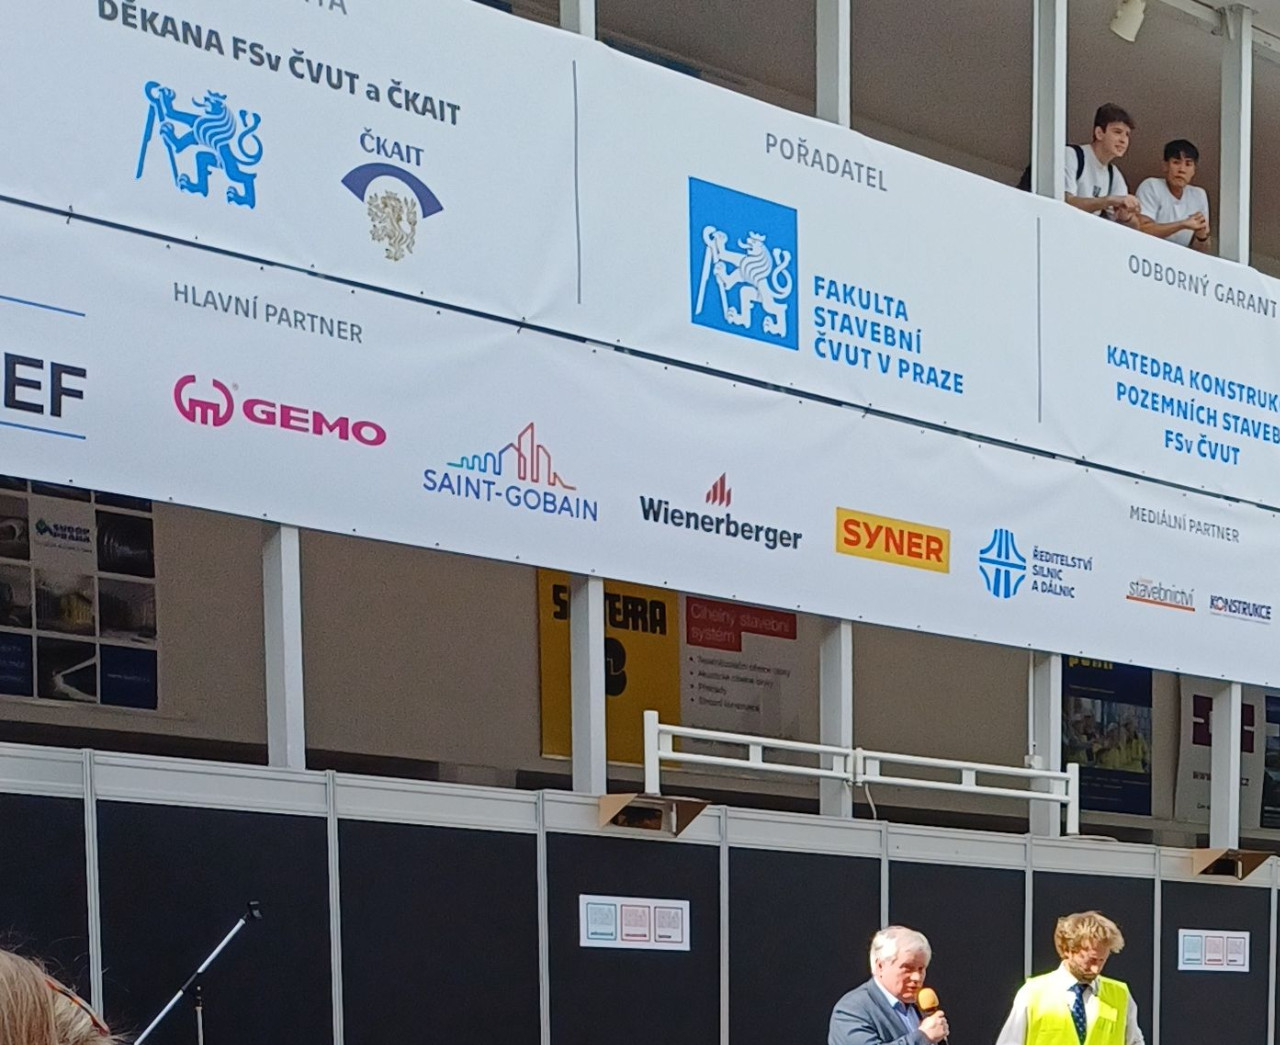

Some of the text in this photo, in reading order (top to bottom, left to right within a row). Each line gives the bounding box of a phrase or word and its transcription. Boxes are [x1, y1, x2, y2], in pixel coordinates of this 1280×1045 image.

[98, 0, 461, 125] DĚKANA FSv ČVUT a ČKAIT
[359, 127, 424, 166] ČKAIT
[766, 133, 887, 192] POŘADATEL
[813, 276, 908, 321] FAKULTA
[1128, 254, 1277, 318] ODBORNÝ GARANT
[173, 281, 363, 344] HLAVNÍ PARTNER
[813, 306, 922, 354] STAVEBNÍ
[813, 331, 964, 394] ČVUT V PRAZE
[1107, 345, 1184, 386] KATEDRA
[242, 398, 387, 447] GEMO
[1116, 381, 1217, 429] POZEMNÍCH
[1164, 429, 1240, 466] FSv ČVUT
[423, 468, 598, 522] SAINT-GOBAIN
[640, 495, 803, 550] Wienerberger
[843, 518, 944, 563] SYNER
[1130, 504, 1240, 544] MEDIÁLNÍ PARTNER
[1032, 546, 1093, 572] ŘEDITELSTVÍ
[1032, 564, 1063, 581] SILNIC
[1031, 580, 1075, 598] A DÁLNIC
[1129, 581, 1195, 607] stavebnictví
[1210, 595, 1272, 620] KONSTRUKCE
